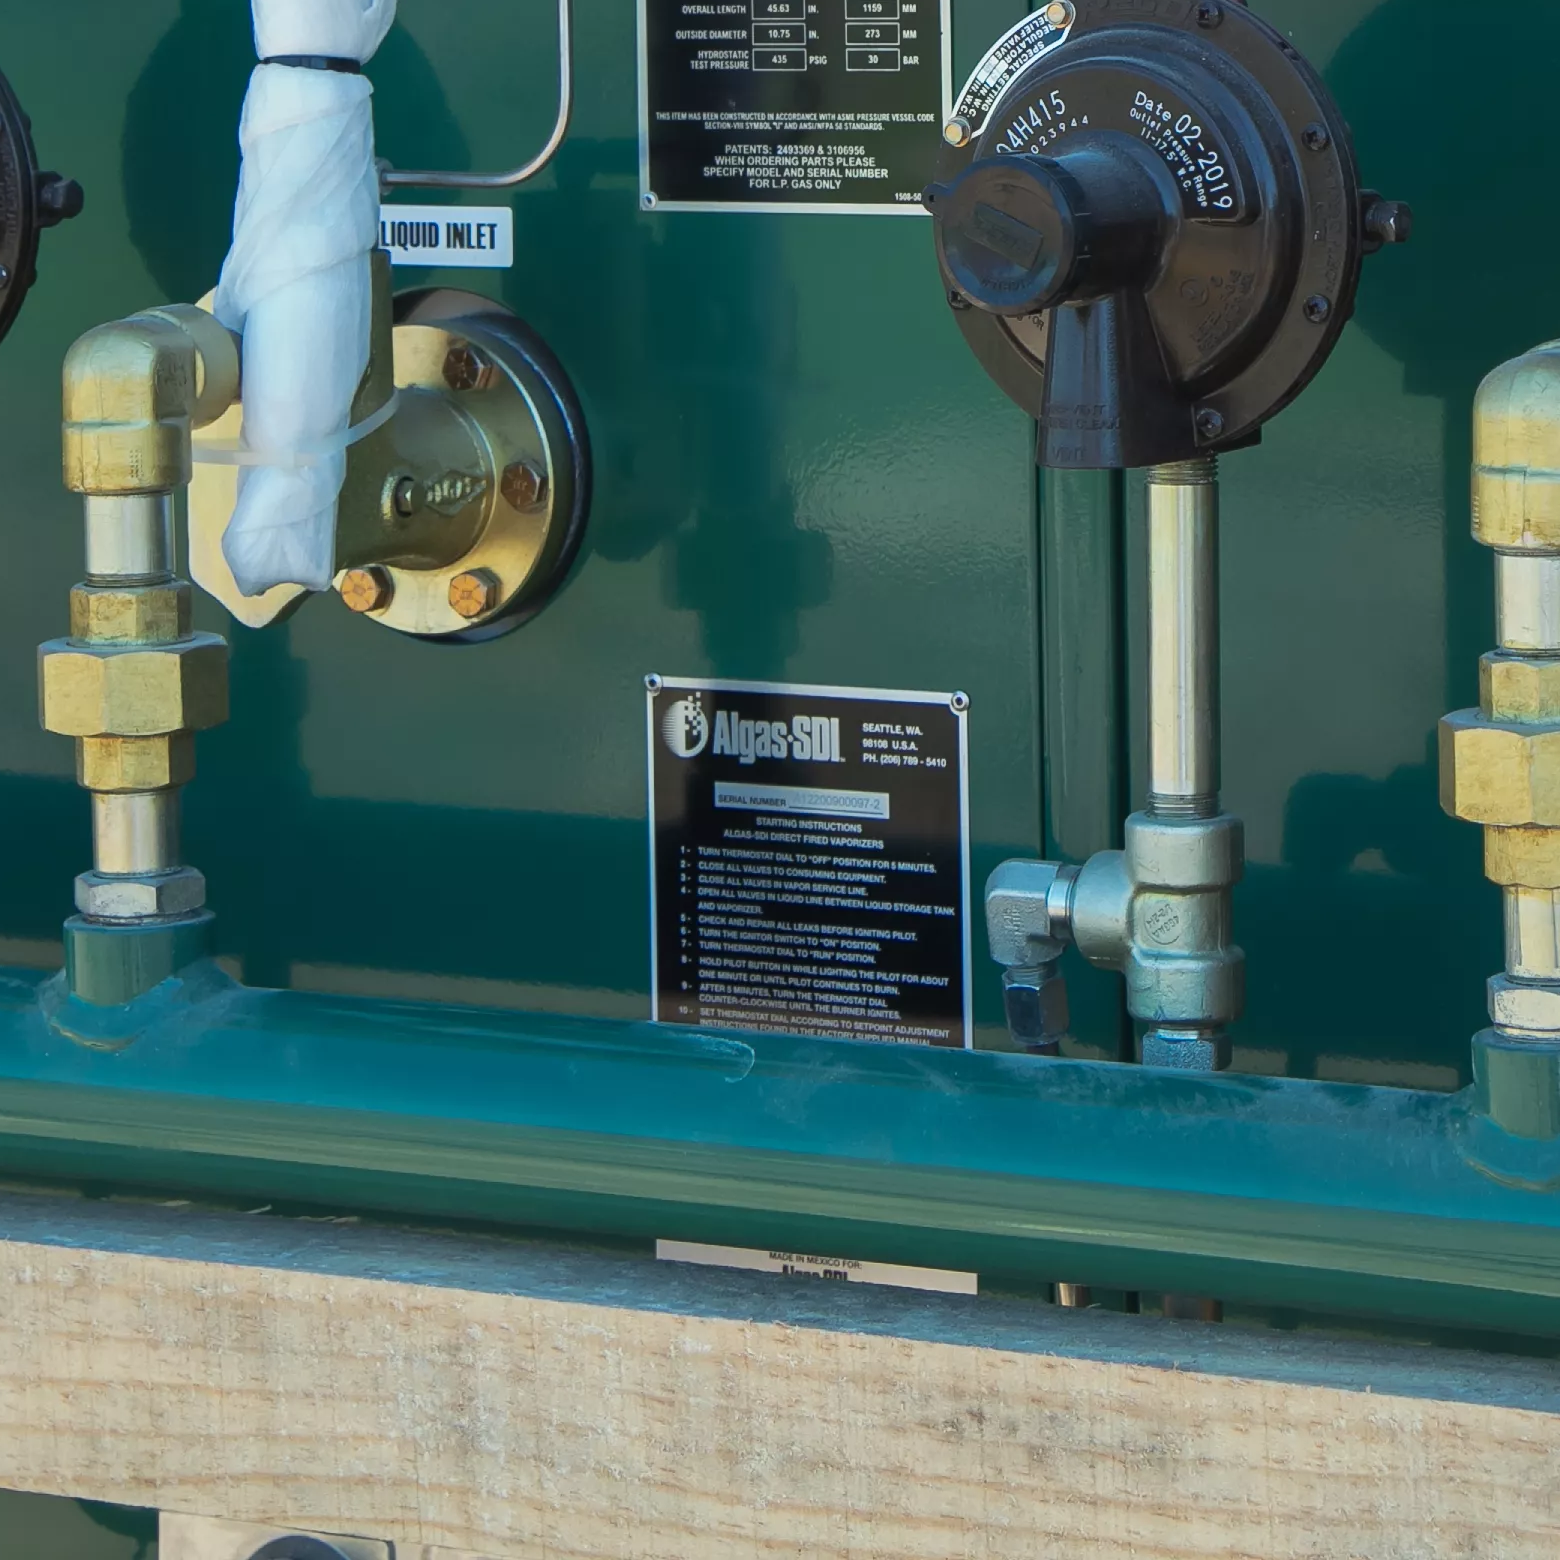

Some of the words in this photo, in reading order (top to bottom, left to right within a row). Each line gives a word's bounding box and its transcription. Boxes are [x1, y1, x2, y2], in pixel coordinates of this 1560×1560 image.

[1014, 41, 1044, 72] SPECIAL
[982, 73, 1010, 112] SETTING
[1130, 108, 1161, 131] Outlet
[1163, 129, 1195, 172] Pressure
[1193, 175, 1207, 207] Range
[1135, 91, 1171, 121] Date
[1175, 114, 1232, 208] 02-2019
[380, 221, 439, 250] LIQUID
[446, 222, 497, 250] INLET
